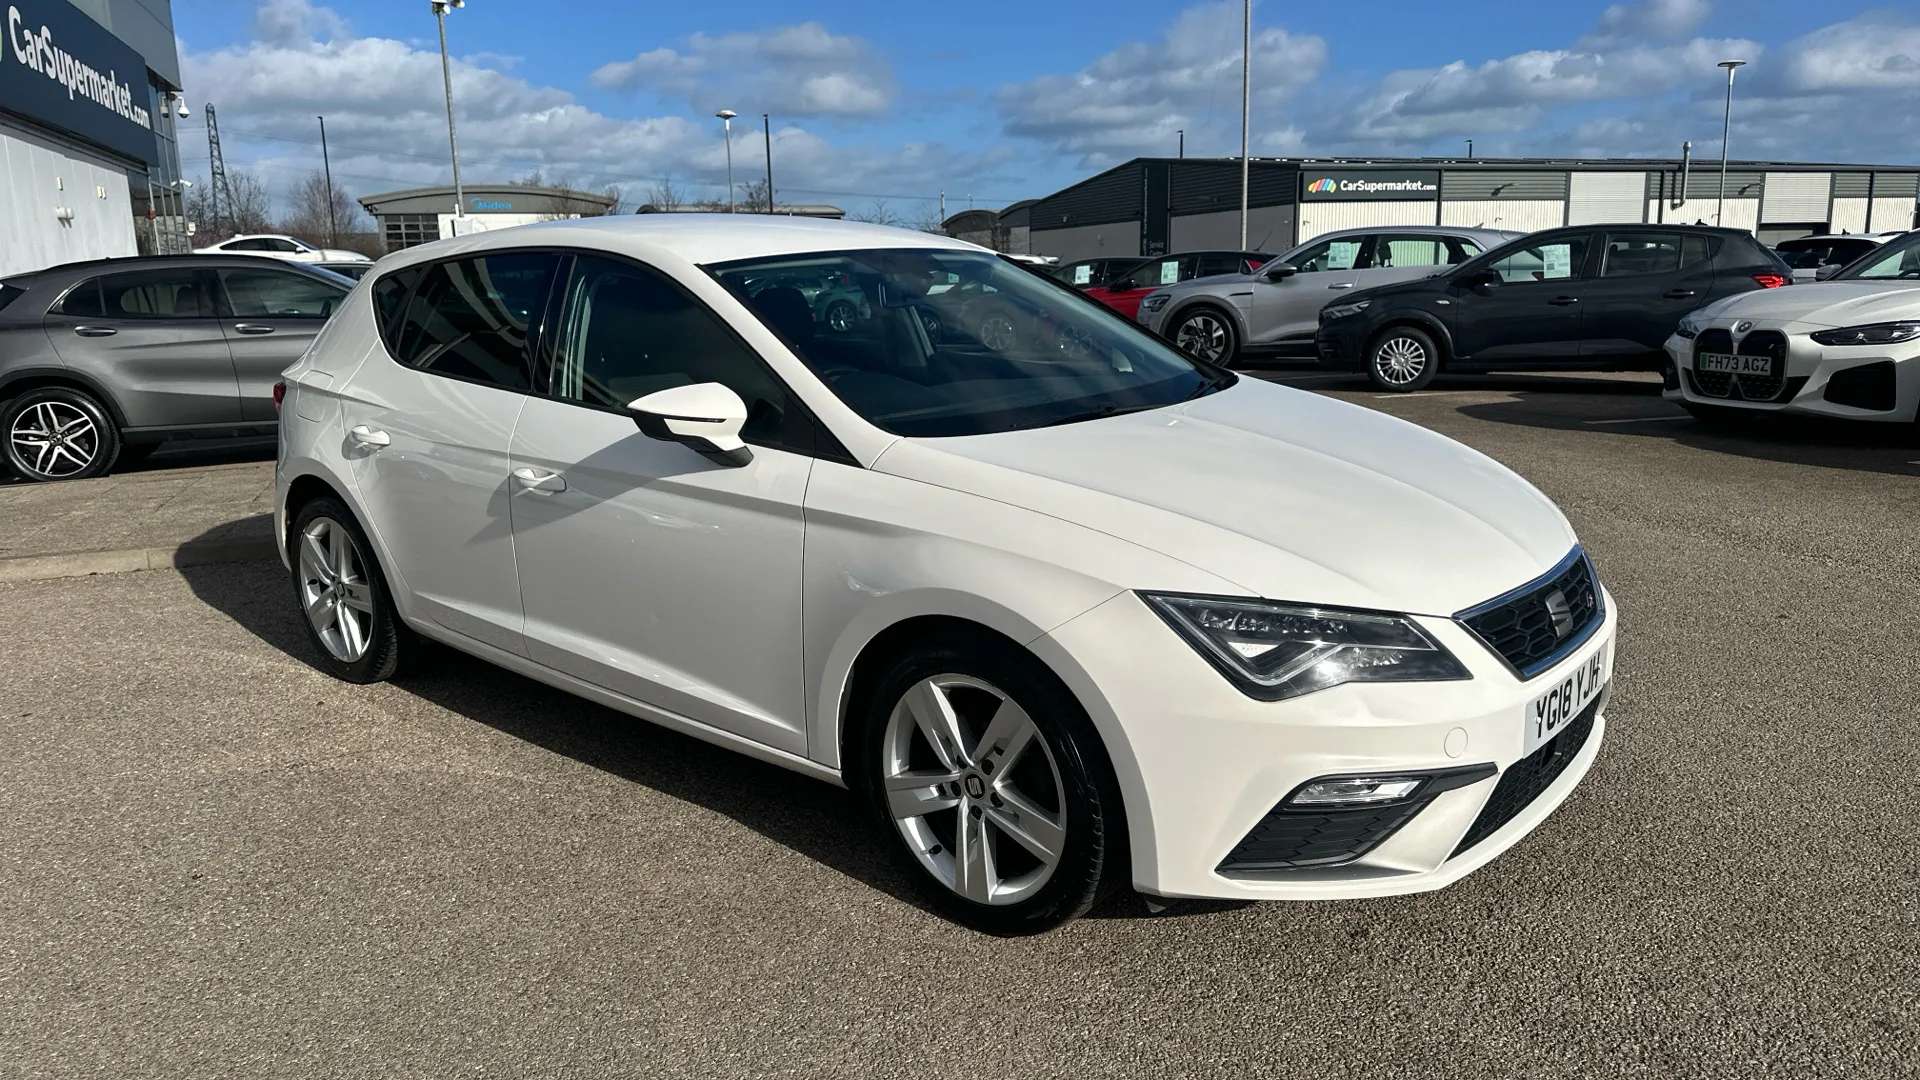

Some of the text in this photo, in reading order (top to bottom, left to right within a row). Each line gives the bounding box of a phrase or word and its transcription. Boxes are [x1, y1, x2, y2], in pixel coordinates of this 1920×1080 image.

[8, 5, 150, 130] CarSupermarket.com
[1340, 179, 1437, 193] CarSupermarket.com
[1707, 354, 1769, 373] FH73 AGZ
[1537, 652, 1600, 738] YG18 YJH
